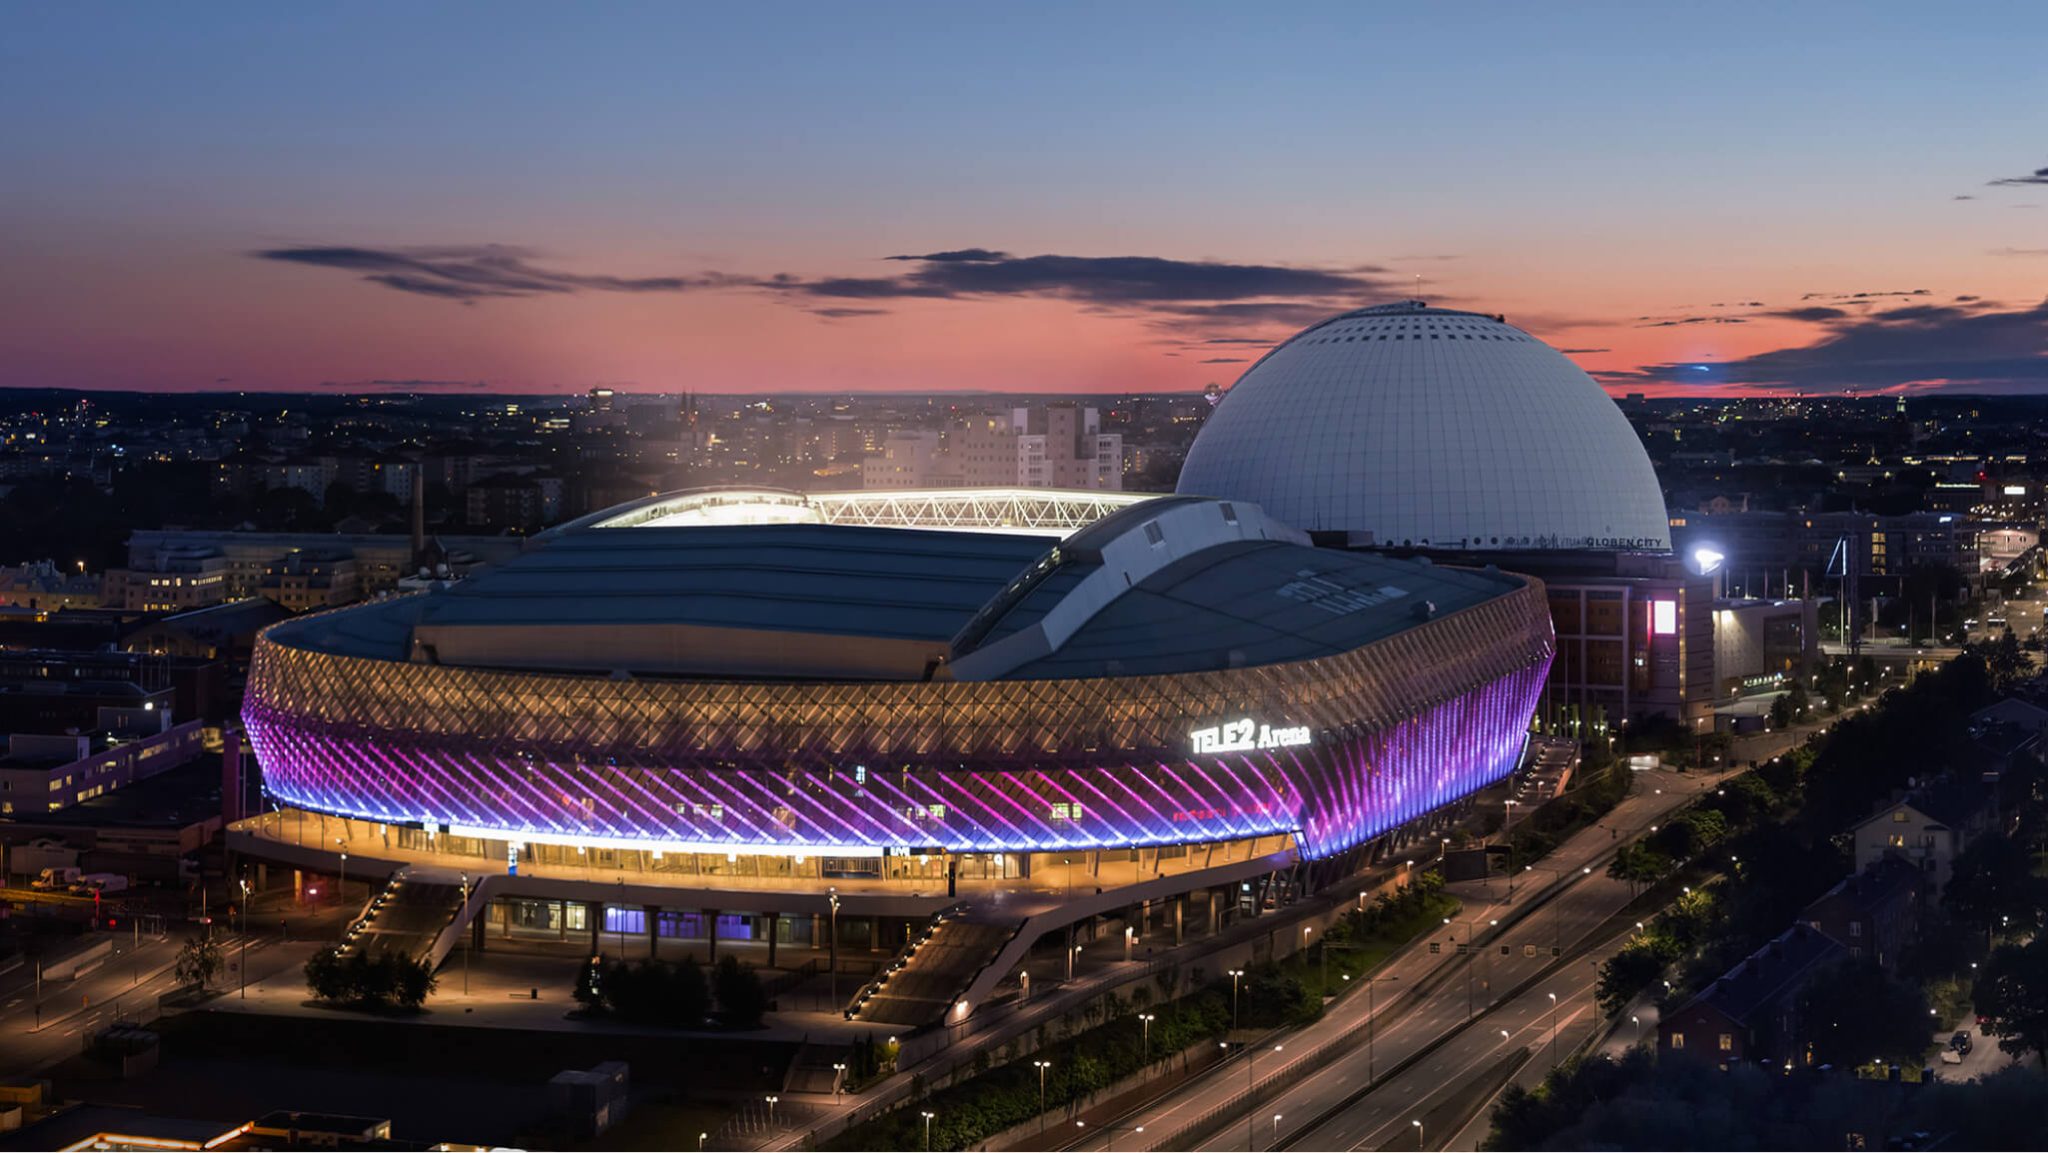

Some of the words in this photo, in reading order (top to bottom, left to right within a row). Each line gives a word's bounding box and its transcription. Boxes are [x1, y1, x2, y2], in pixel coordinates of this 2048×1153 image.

[1637, 537, 1662, 547] CITY
[1190, 718, 1255, 753] TELE2
[1257, 724, 1311, 748] Arena
